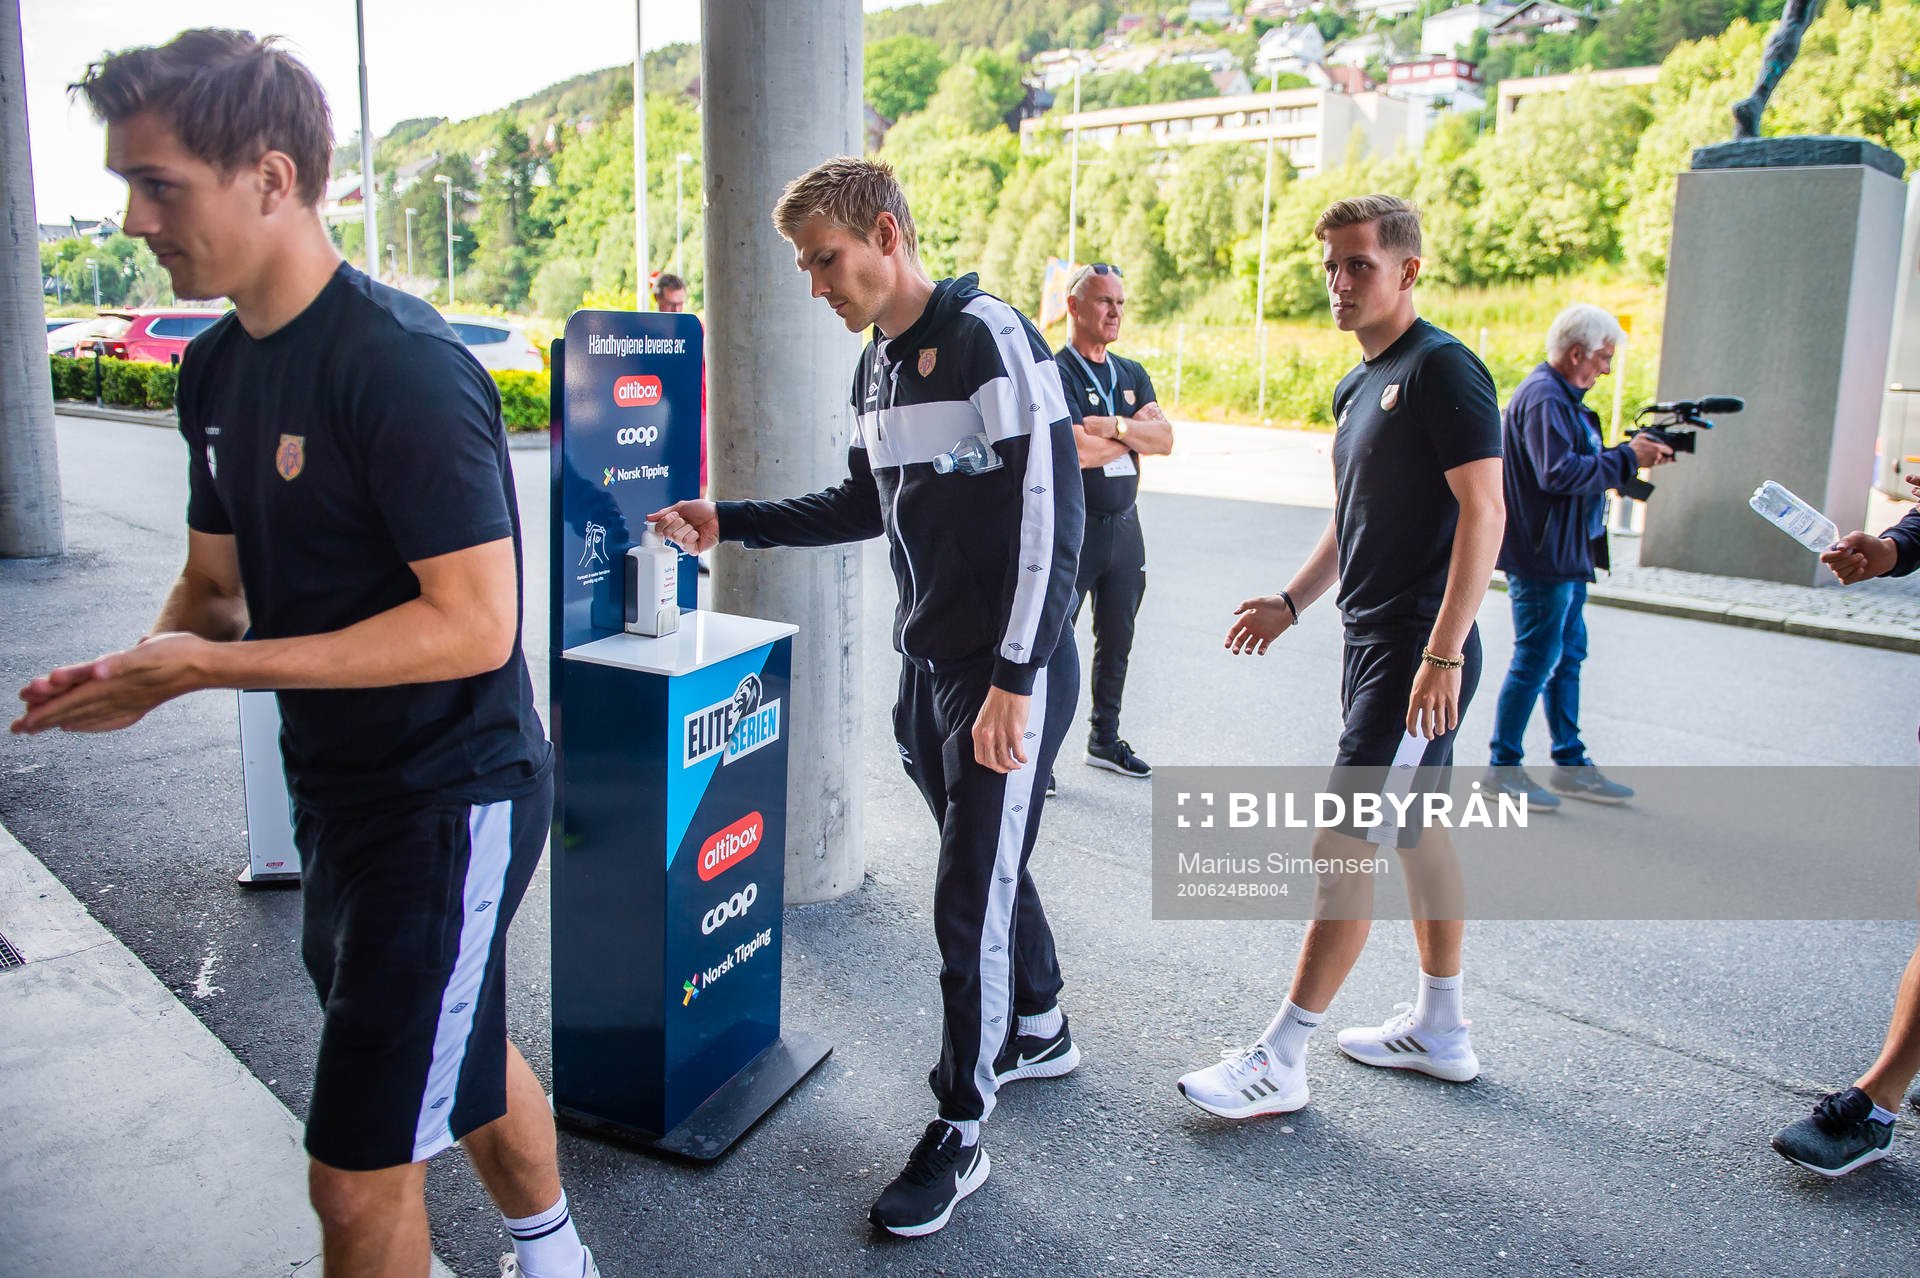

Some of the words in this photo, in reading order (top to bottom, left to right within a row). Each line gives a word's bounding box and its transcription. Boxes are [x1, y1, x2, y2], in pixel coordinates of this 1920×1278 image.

[589, 334, 643, 357] Håndhygiene
[645, 335, 672, 355] leveres
[674, 338, 686, 354] av:
[618, 381, 658, 400] altibox
[616, 425, 658, 447] coop
[617, 468, 641, 482] Norsk
[642, 464, 669, 480] Tipping
[687, 703, 735, 761] ELITE
[729, 705, 778, 757] SERIEN
[703, 822, 759, 871] altibox
[701, 882, 758, 936] coop
[702, 953, 734, 989] Norsk
[734, 926, 772, 964] Tipping
